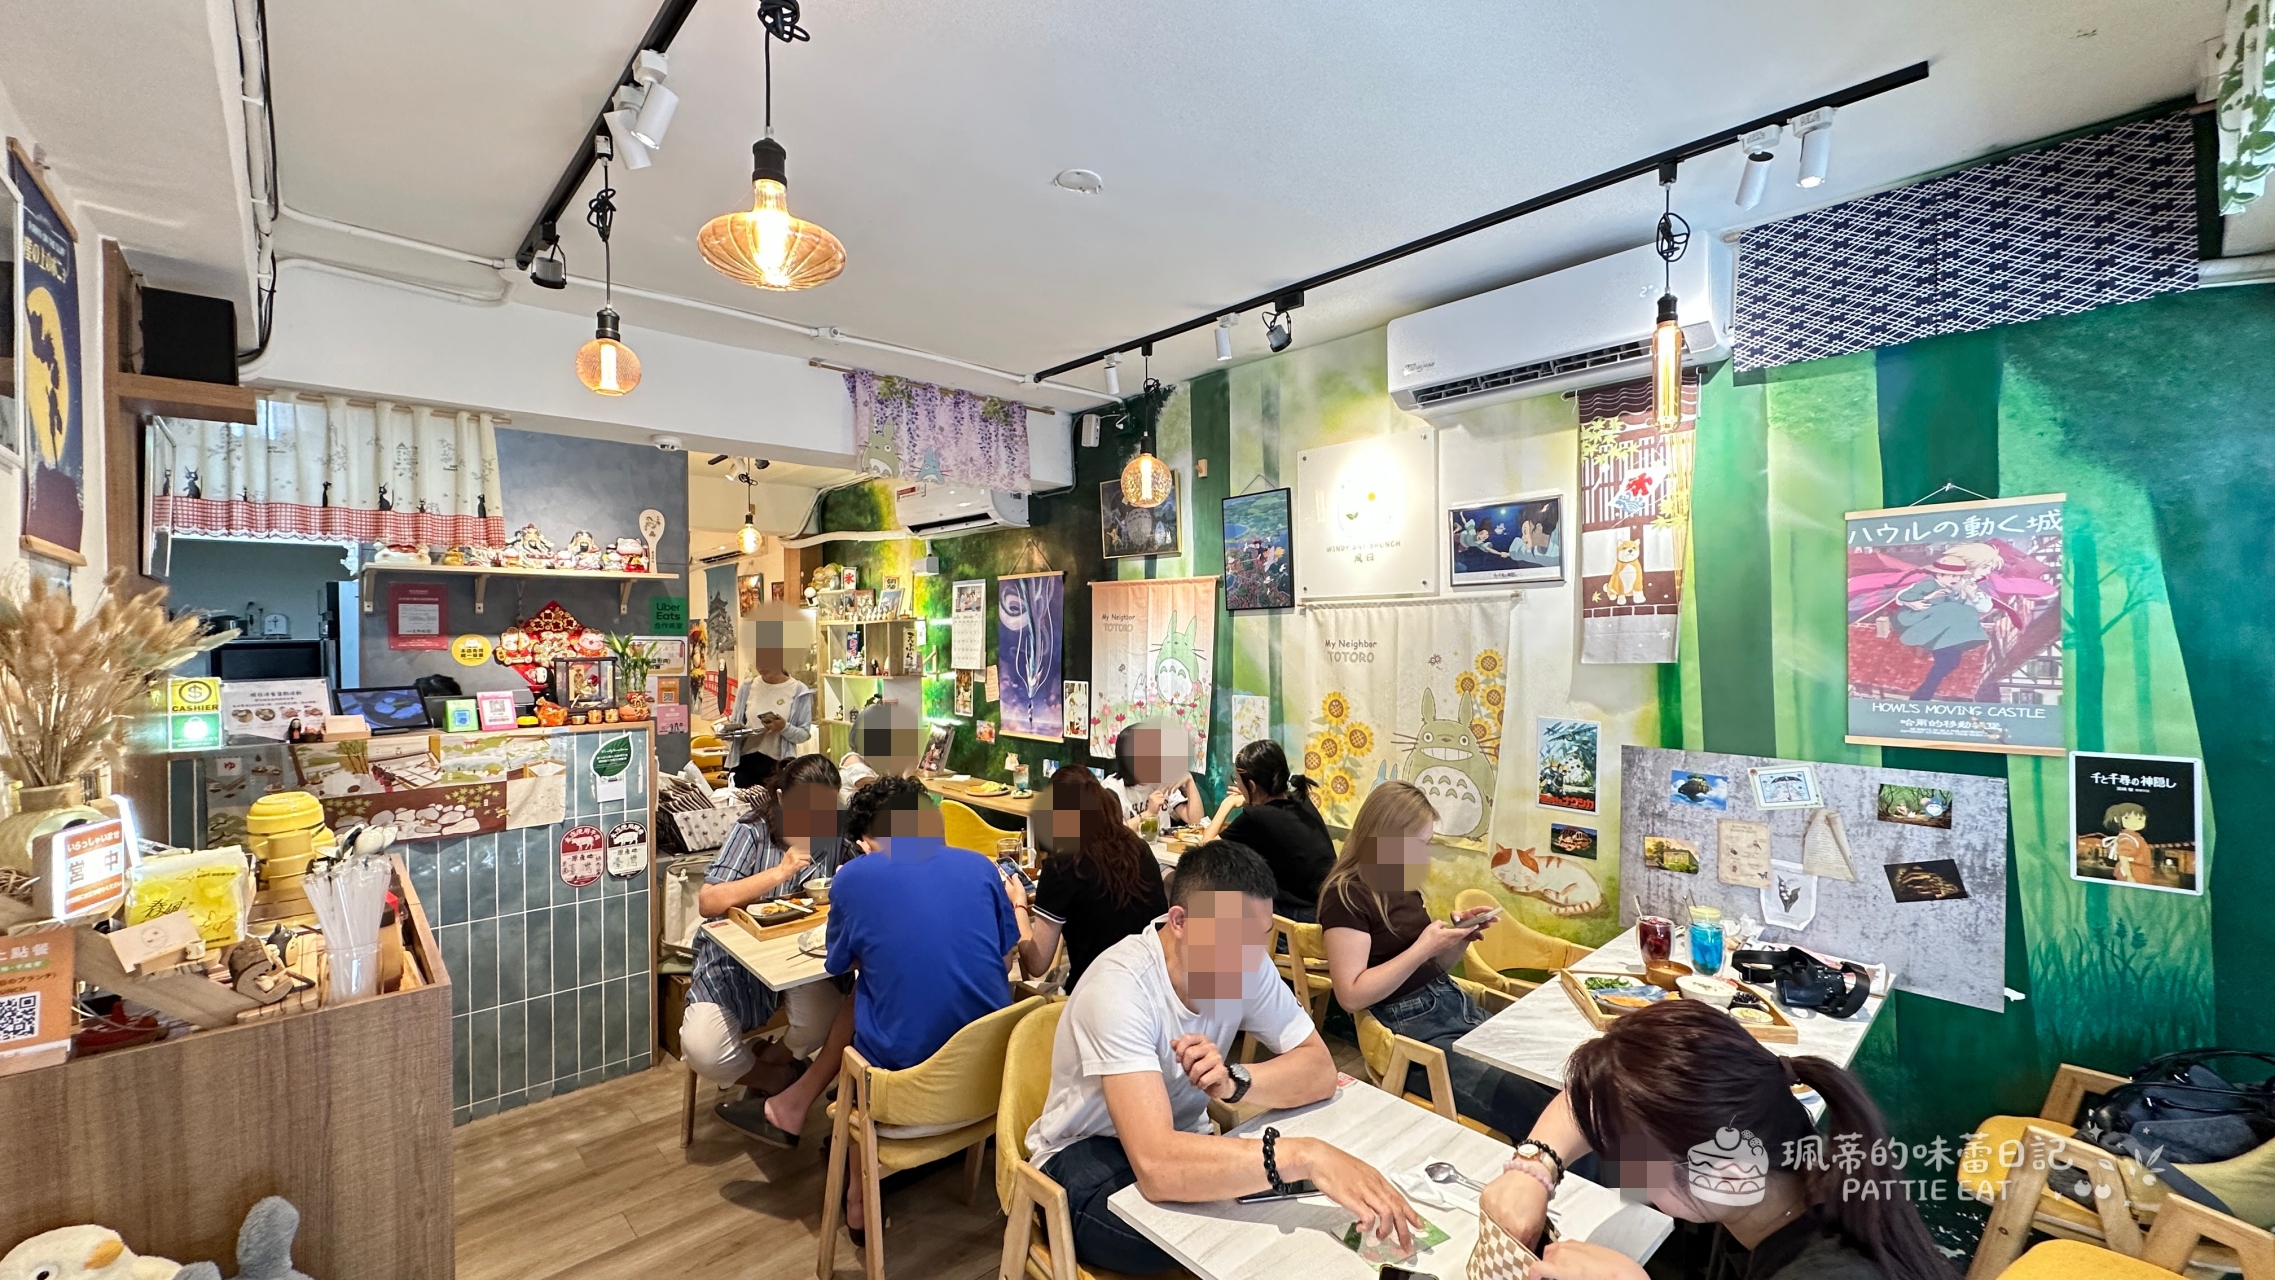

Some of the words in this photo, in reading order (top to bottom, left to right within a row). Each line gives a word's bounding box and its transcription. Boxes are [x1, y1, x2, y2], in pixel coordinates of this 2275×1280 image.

[1848, 508, 2063, 544] ハウルの動く城
[1326, 545, 1350, 553] WINDY
[1370, 540, 1401, 550] BRUNCH
[656, 602, 681, 611] Uber
[656, 611, 681, 620] Eats
[1101, 613, 1109, 621] My
[1111, 613, 1136, 622] Neighbor
[1103, 622, 1134, 632] TOTORO
[1325, 639, 1336, 649] My
[1338, 639, 1377, 650] Neighbor
[1327, 651, 1375, 663] TOTORO
[171, 704, 219, 713] CASHIER
[1872, 702, 1921, 714] HOWL'S
[1925, 704, 1983, 716] MOVING
[1987, 706, 2047, 719] CASTLE
[2090, 771, 2178, 789] 千と千尋の神隠し
[67, 830, 120, 852] いらっしゃいませ
[69, 850, 119, 885] 営中
